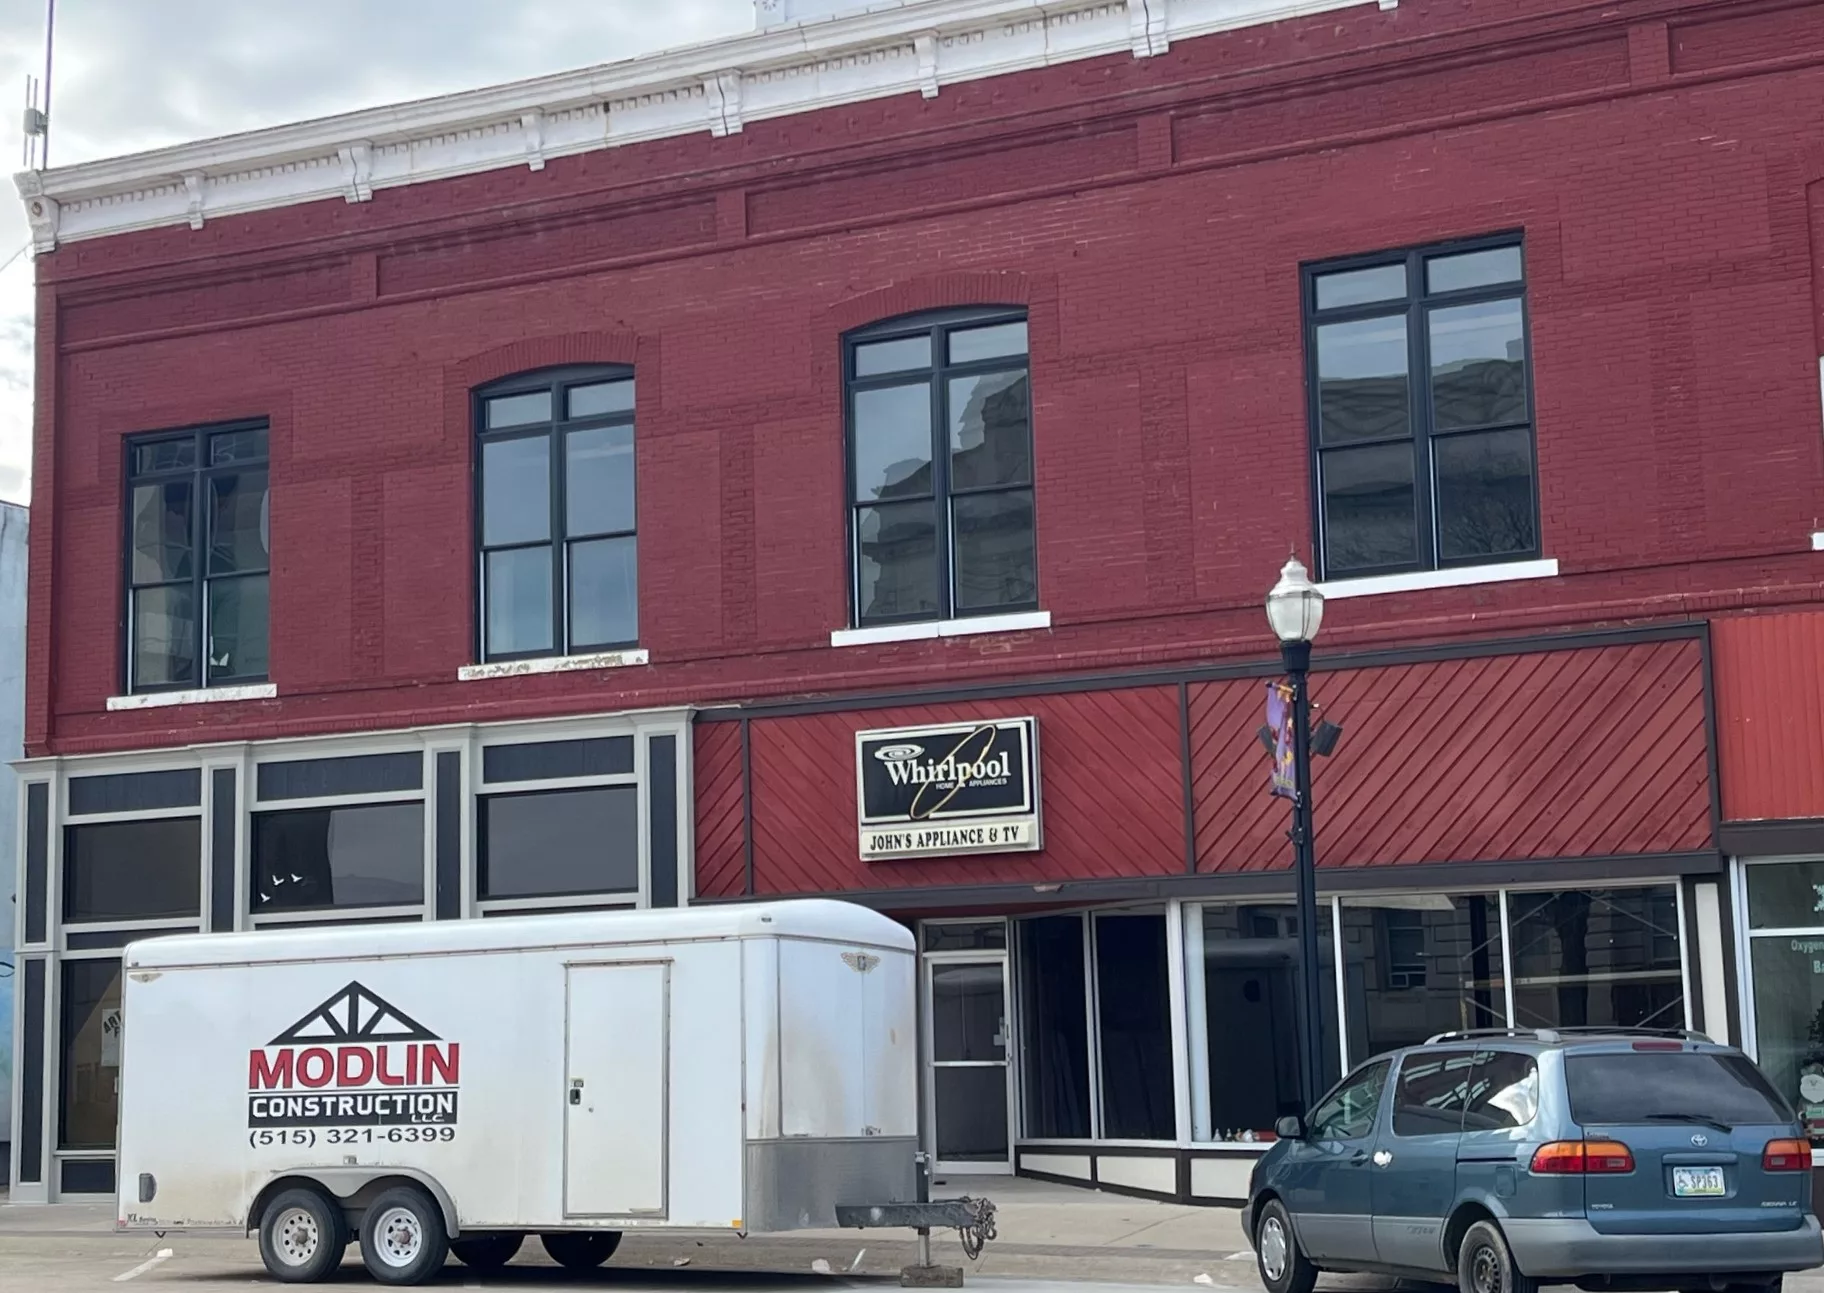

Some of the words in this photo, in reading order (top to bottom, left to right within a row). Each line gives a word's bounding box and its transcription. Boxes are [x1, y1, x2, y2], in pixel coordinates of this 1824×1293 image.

[884, 752, 1012, 787] Whirlpool
[935, 782, 955, 790] HOME
[968, 778, 1008, 787] APPLIANCES
[870, 834, 912, 851] JOHN'S
[916, 828, 984, 848] APPLIANCE
[988, 828, 998, 842] &
[1003, 826, 1020, 841] TV
[249, 1043, 460, 1089] MODLIN
[252, 1093, 454, 1117] CONSTRUCTION
[411, 1113, 445, 1123] LLC
[249, 1129, 317, 1148] (515)
[326, 1127, 456, 1144] 321-6399
